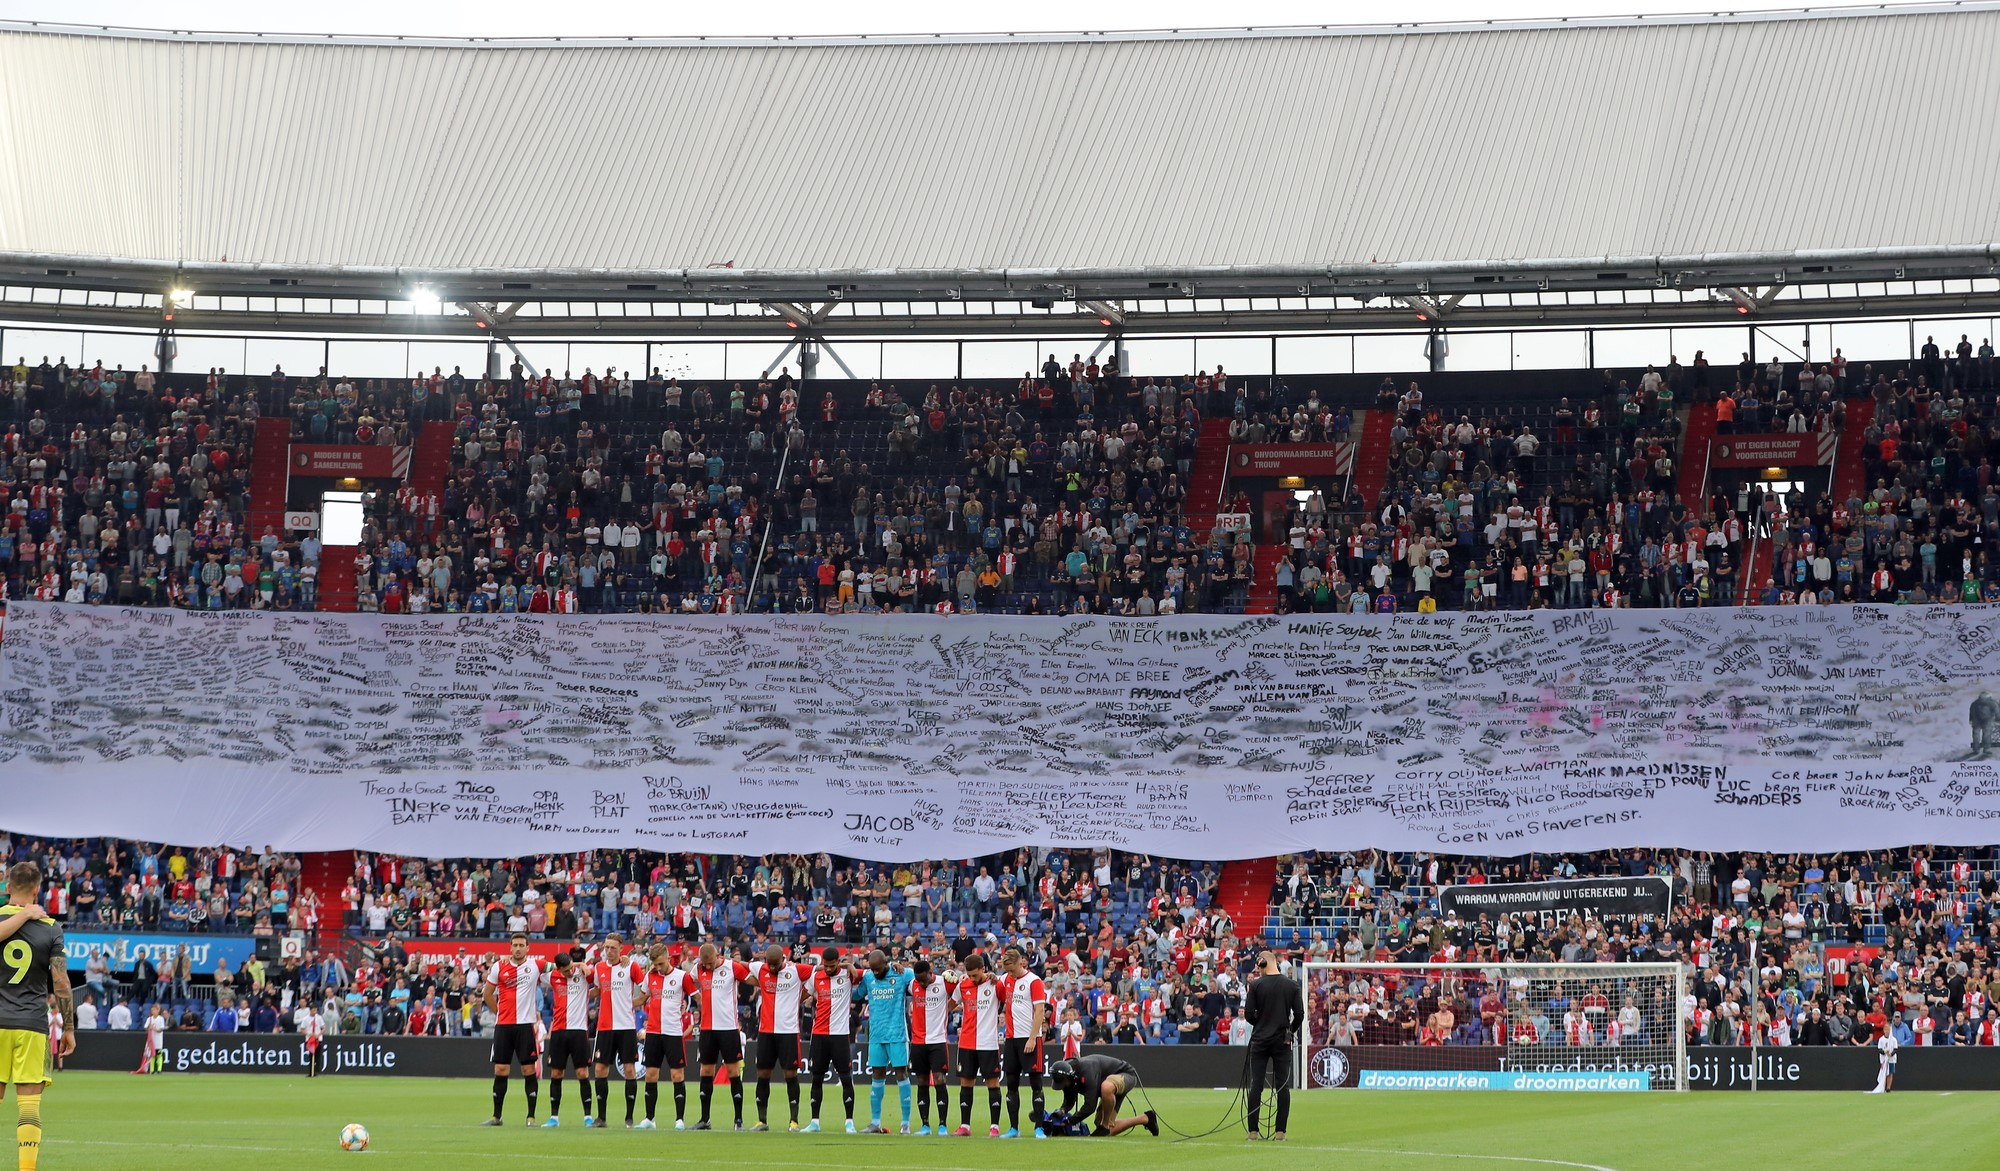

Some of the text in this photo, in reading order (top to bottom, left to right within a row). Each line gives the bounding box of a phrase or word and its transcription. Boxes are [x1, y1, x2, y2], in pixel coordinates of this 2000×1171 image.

[1736, 451, 1796, 459] VOORTGEBRACHT
[533, 791, 558, 801] OPA
[392, 814, 439, 825] BART
[844, 814, 915, 832] JACOB
[1543, 891, 1560, 901] NOU
[1563, 888, 1627, 899] UITGEREKEND
[3, 940, 32, 984] 9
[177, 1042, 292, 1069] gedachten
[300, 1044, 328, 1072] bj
[336, 1043, 395, 1072] jullie
[1686, 1055, 1719, 1086] bij
[1729, 1056, 1800, 1086] jullie
[1364, 1073, 1489, 1089] droomparken
[1514, 1074, 1640, 1091] droomparken
